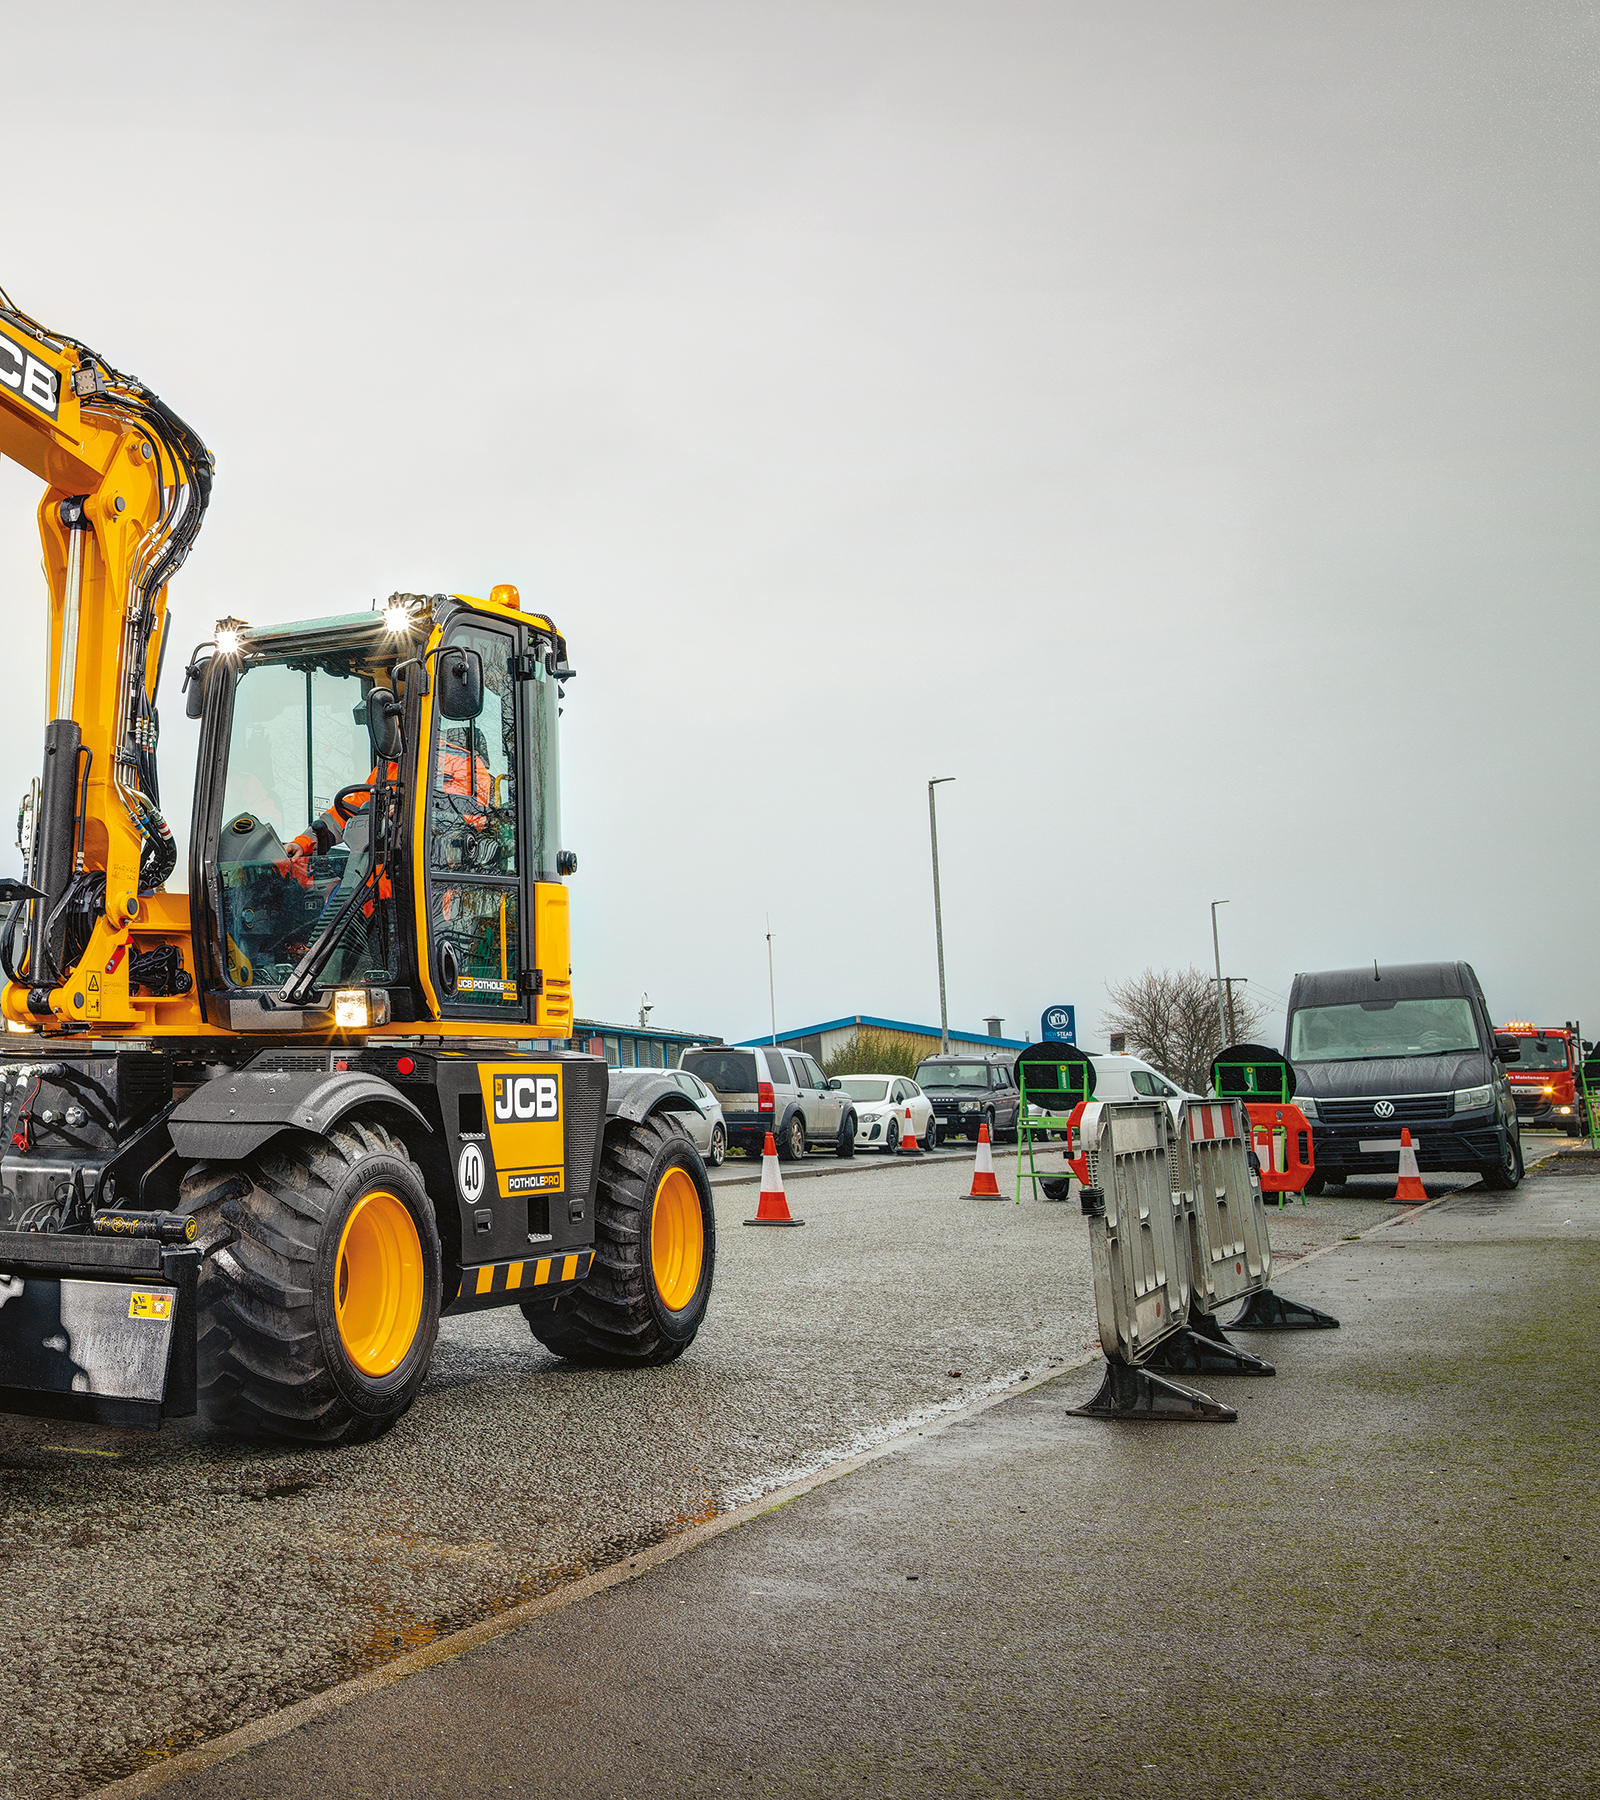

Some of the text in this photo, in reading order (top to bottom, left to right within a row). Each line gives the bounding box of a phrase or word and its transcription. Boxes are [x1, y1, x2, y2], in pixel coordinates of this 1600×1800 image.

[458, 979, 473, 989] JCB
[495, 1078, 558, 1119] JCB
[465, 1155, 479, 1191] 40
[509, 1174, 559, 1190] POTHOLEPRO
